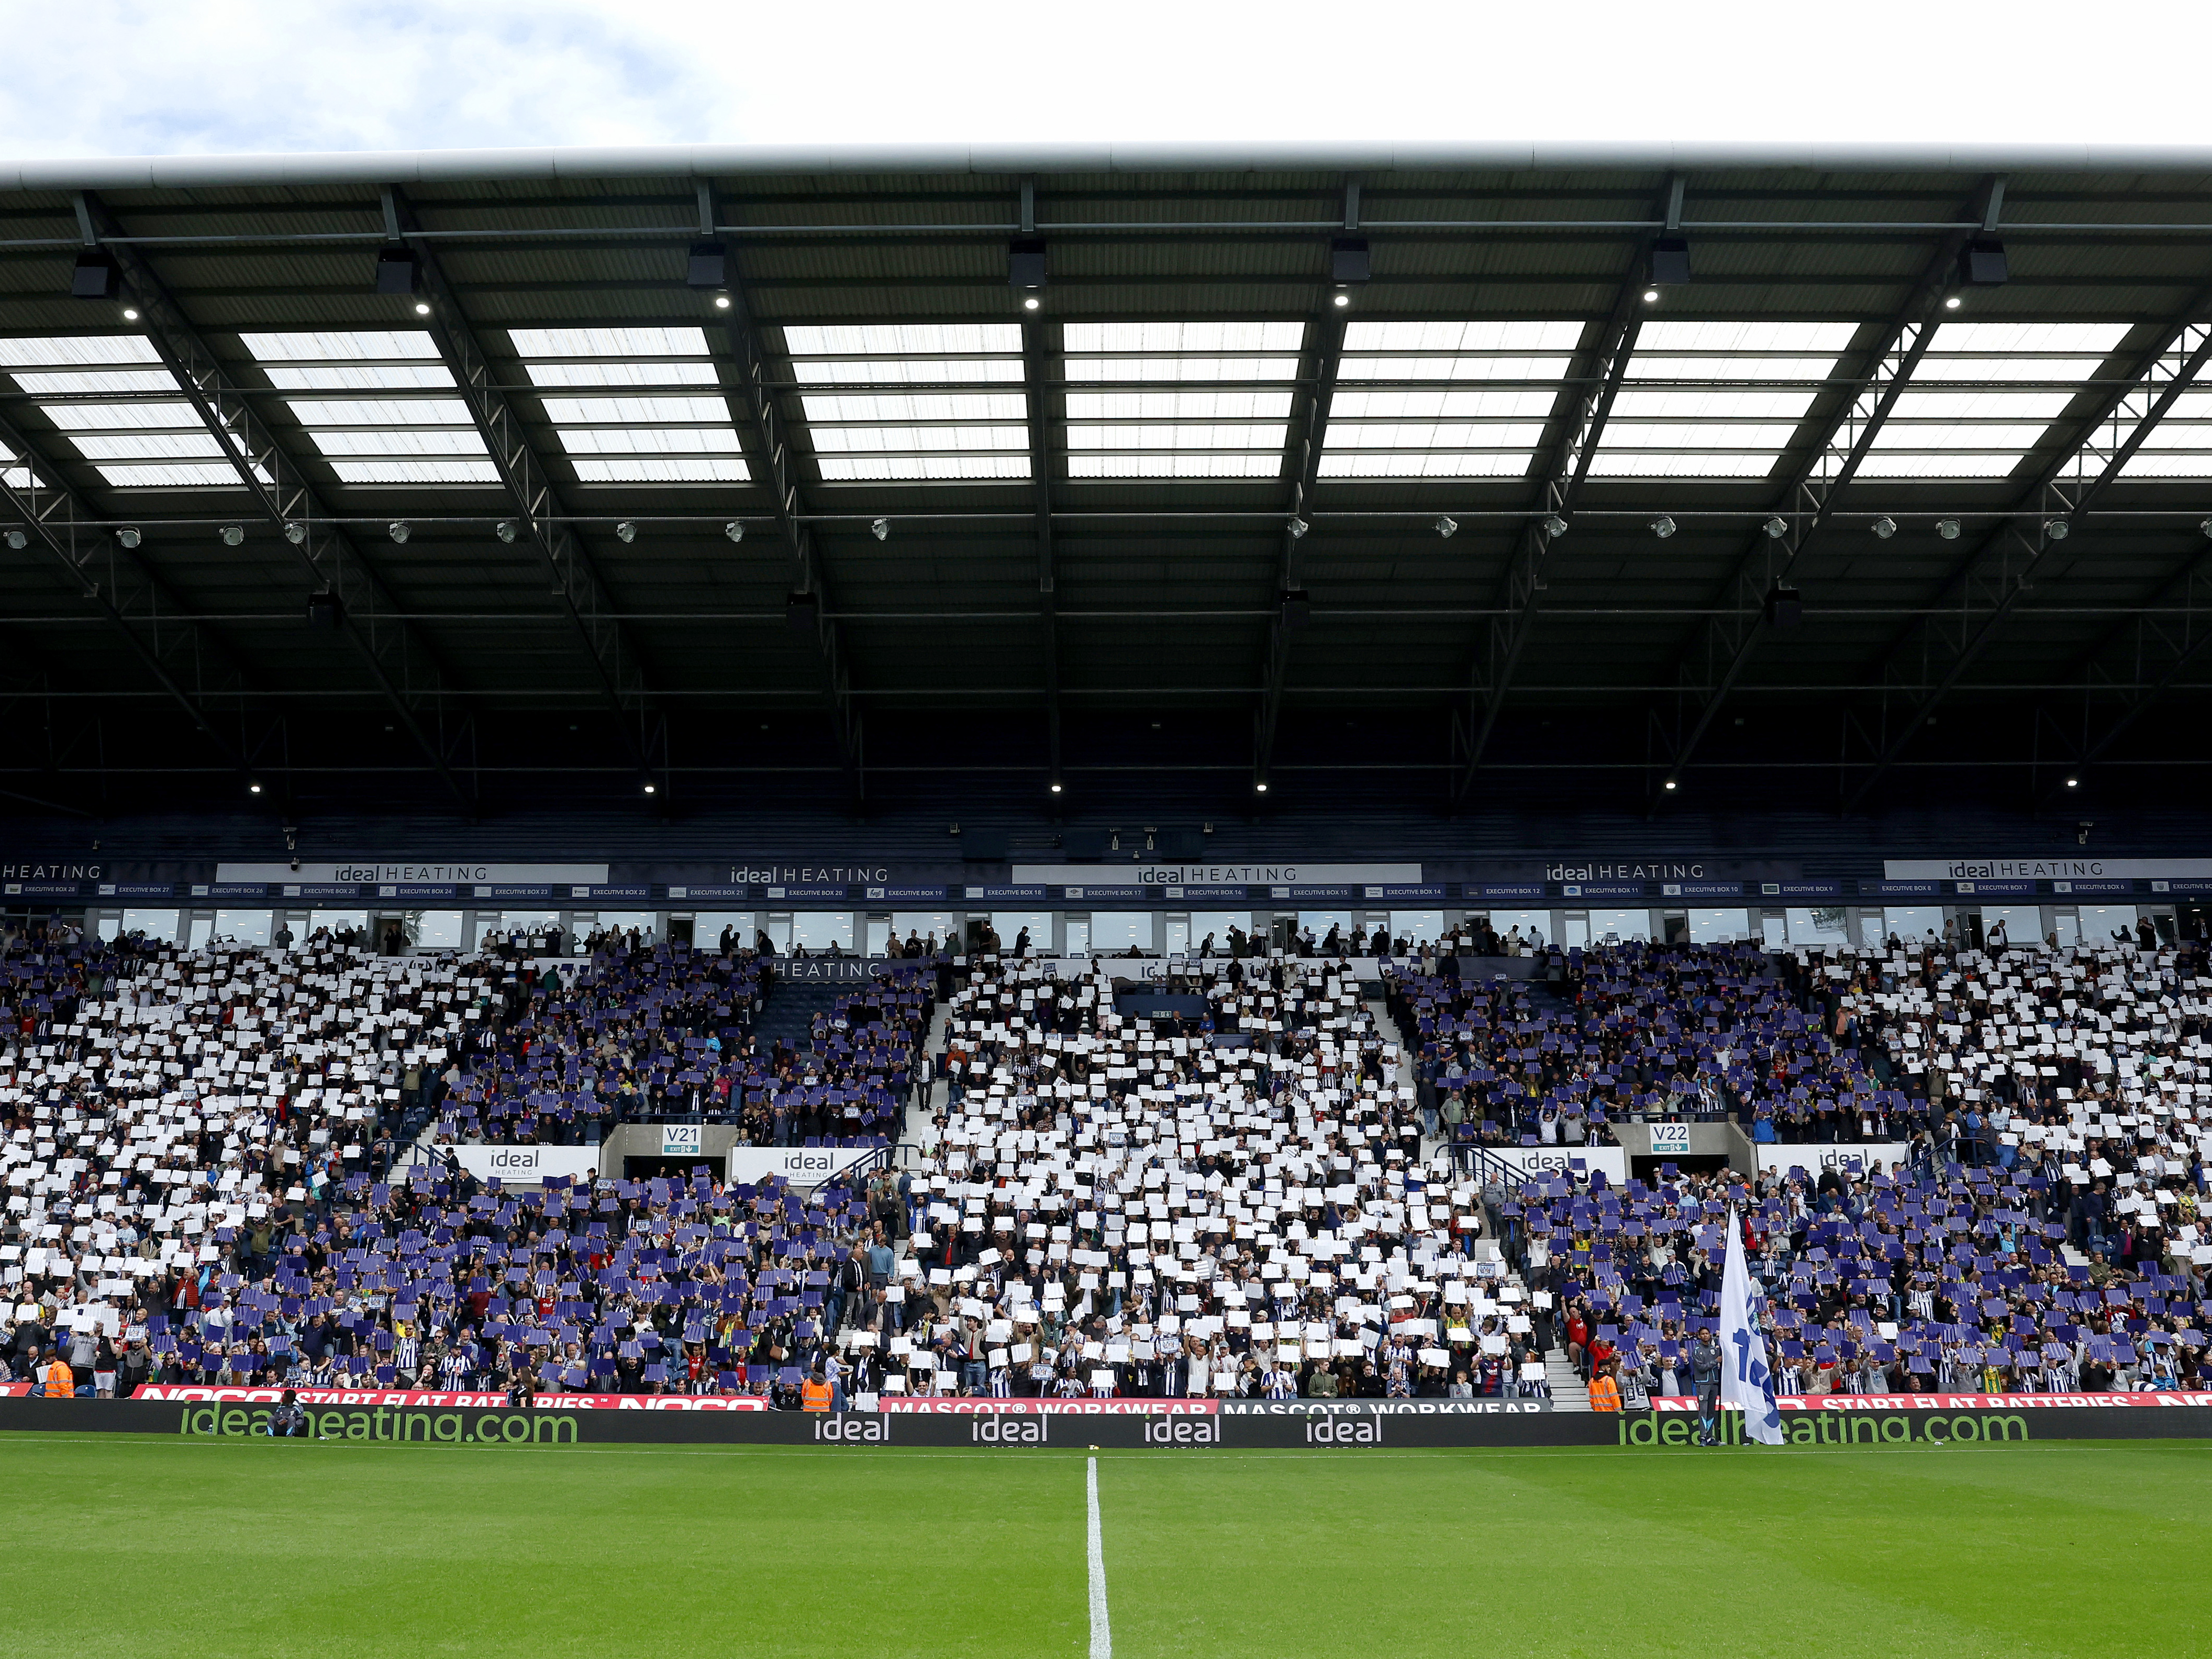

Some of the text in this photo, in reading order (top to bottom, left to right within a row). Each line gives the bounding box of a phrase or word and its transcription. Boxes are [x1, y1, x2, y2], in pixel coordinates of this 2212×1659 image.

[3, 865, 101, 878] HEATING
[335, 865, 487, 881] ideal HEATING
[731, 866, 887, 883] ideal HEATING
[1138, 867, 1296, 883] ideal HEATING
[1546, 864, 1703, 880] ideal HEATING
[1948, 861, 2103, 878] ideal HEATING
[666, 1127, 697, 1142] V21
[1653, 1126, 1687, 1140] V22
[491, 1149, 539, 1167] ideal
[784, 1152, 833, 1170] ideal
[1521, 1151, 1571, 1169] ideal
[815, 1412, 889, 1441] ideal
[973, 1413, 1048, 1442] ideal
[1144, 1414, 1220, 1443] ideal
[1306, 1414, 1382, 1443] ideal
